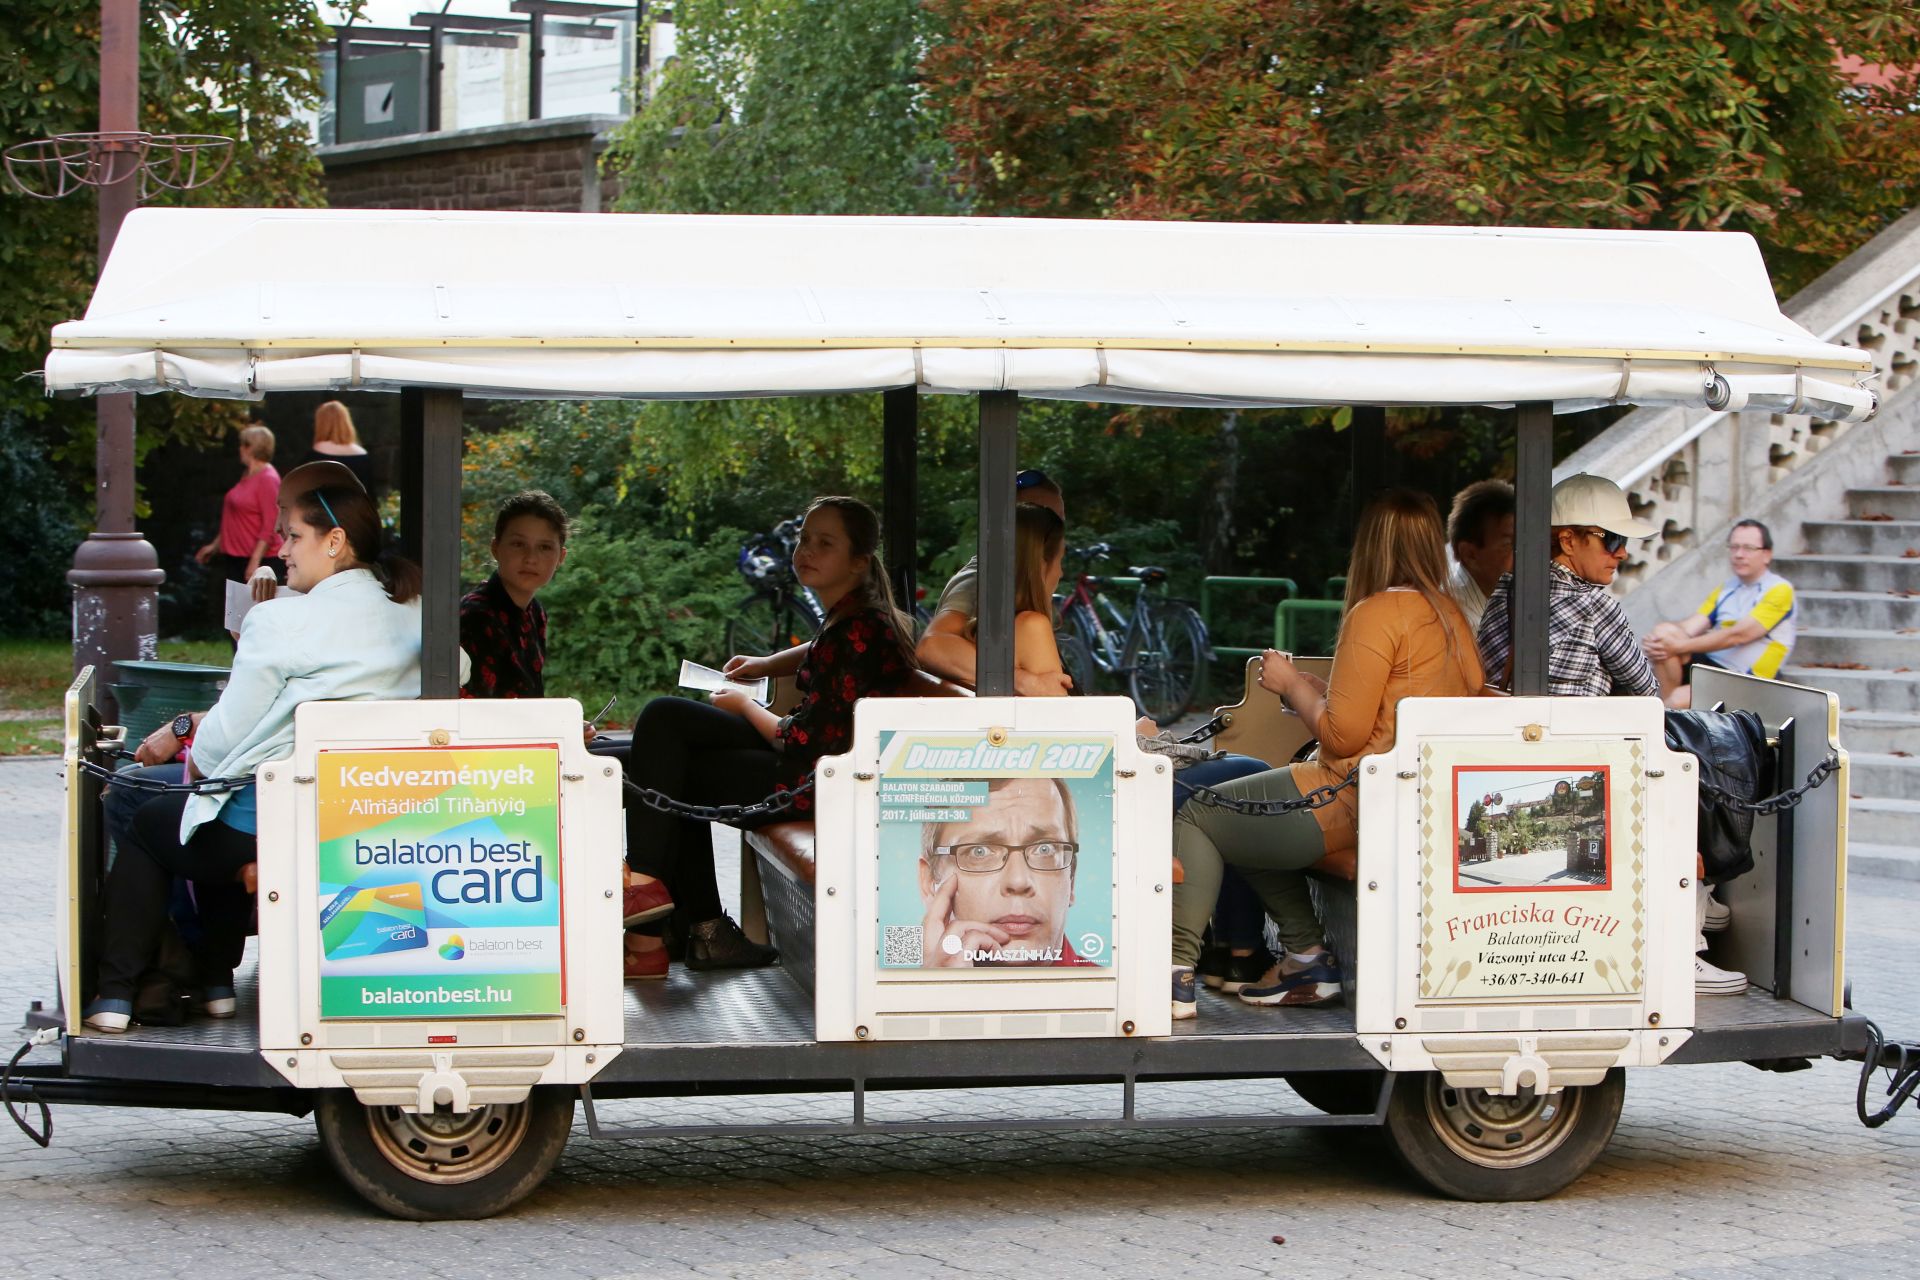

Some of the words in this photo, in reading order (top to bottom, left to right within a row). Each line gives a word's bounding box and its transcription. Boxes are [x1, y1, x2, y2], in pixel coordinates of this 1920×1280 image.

[1041, 743, 1105, 770] 2017
[340, 764, 534, 790] Kedvezmények
[883, 783, 919, 792] BALATON
[920, 782, 965, 792] SZABADIDŐ
[445, 798, 526, 816] Tihanyig
[882, 793, 891, 803] ÉS
[950, 793, 986, 804] KÖZPONT
[882, 810, 907, 820] 2017.
[909, 810, 936, 822] július
[937, 810, 968, 820] 21-30.
[355, 838, 461, 865] balaton
[470, 837, 531, 864] best
[432, 855, 543, 904] card
[1445, 902, 1555, 942] Franciska
[1564, 906, 1620, 937] Grill
[390, 926, 416, 940] card
[1487, 930, 1581, 948] Balatonfüred
[469, 938, 514, 951] balaton
[516, 938, 543, 951] best
[963, 946, 1063, 961] DUMASZÍNHÁZ
[1478, 951, 1536, 966] Vázsonyi
[1538, 952, 1566, 963] utca
[1570, 950, 1588, 962] 42.
[1480, 971, 1585, 986] +36/87-340-641
[362, 986, 512, 1005] balatonbest.hu
